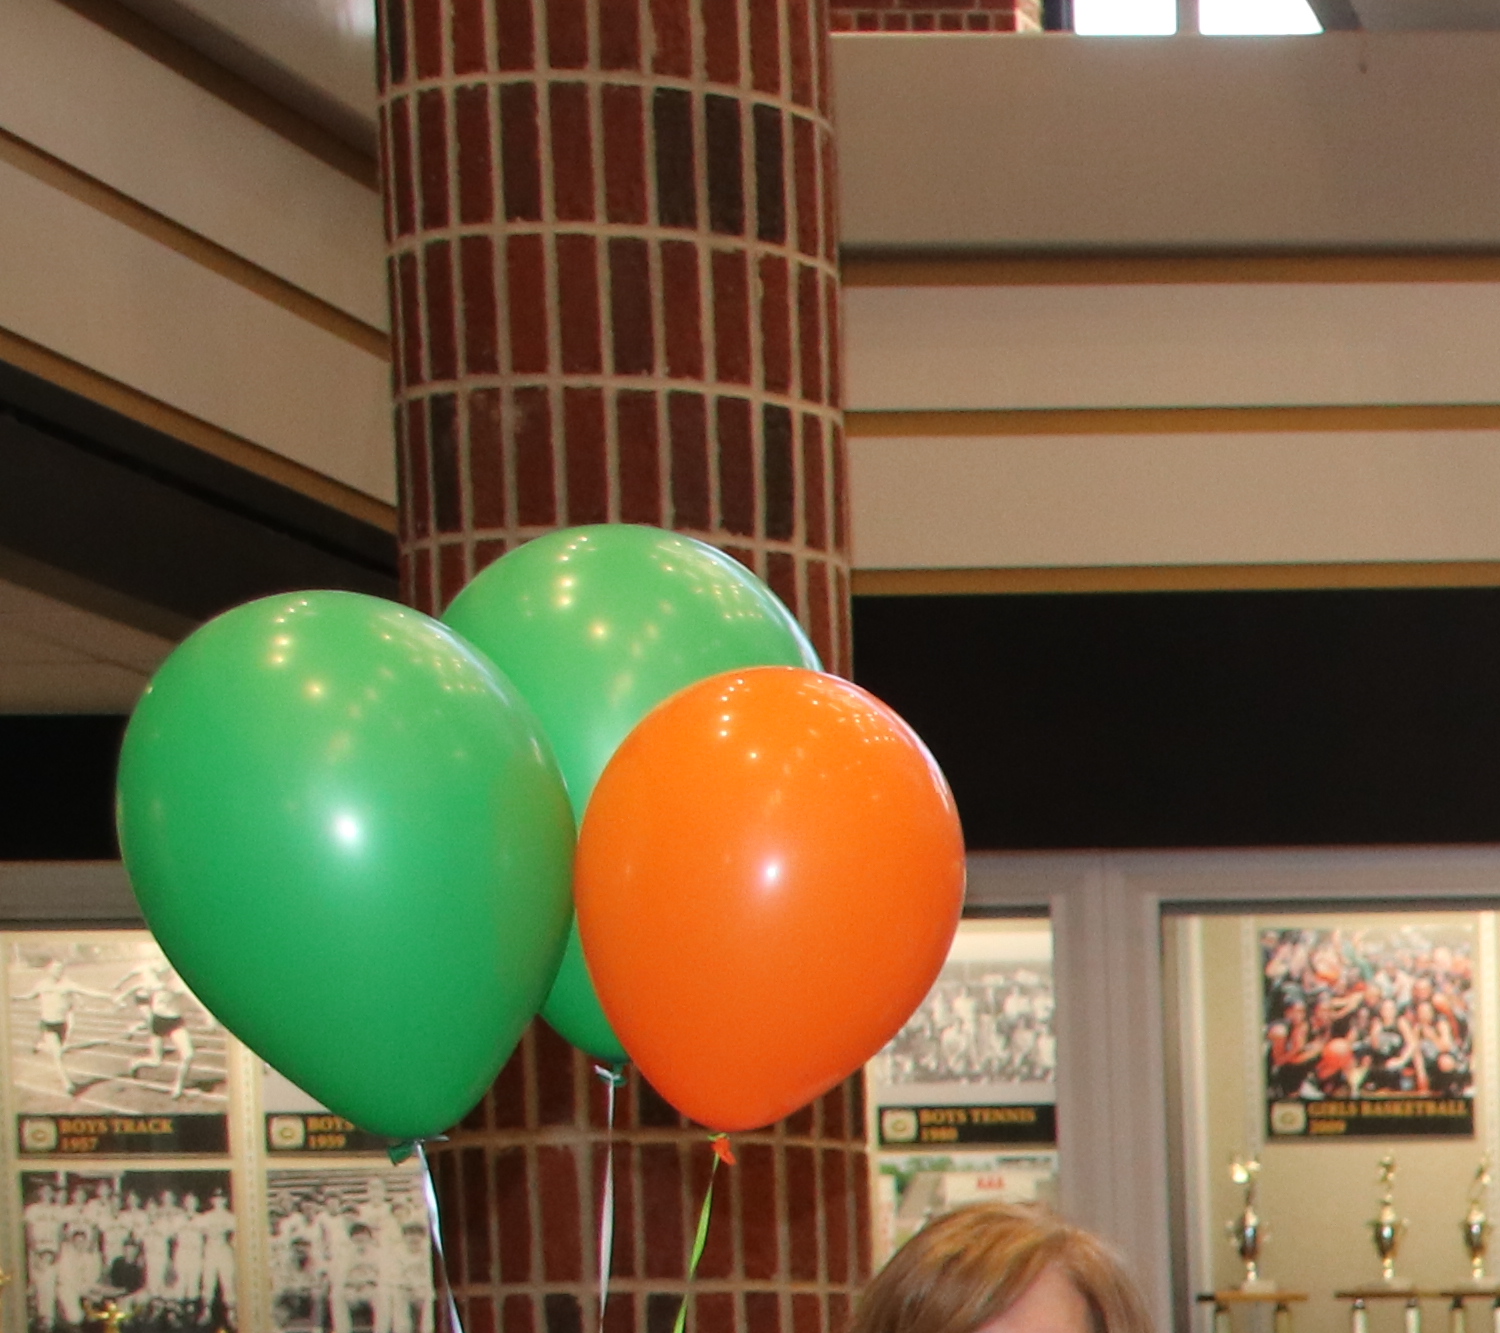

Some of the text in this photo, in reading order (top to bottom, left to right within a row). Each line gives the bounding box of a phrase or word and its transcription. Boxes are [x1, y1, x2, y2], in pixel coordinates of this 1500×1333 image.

[920, 1108, 1036, 1124] BOYS TENNIS
[1308, 1100, 1467, 1117] GIRLS BASKETBALL
[59, 1118, 174, 1134] BOYS TRACK
